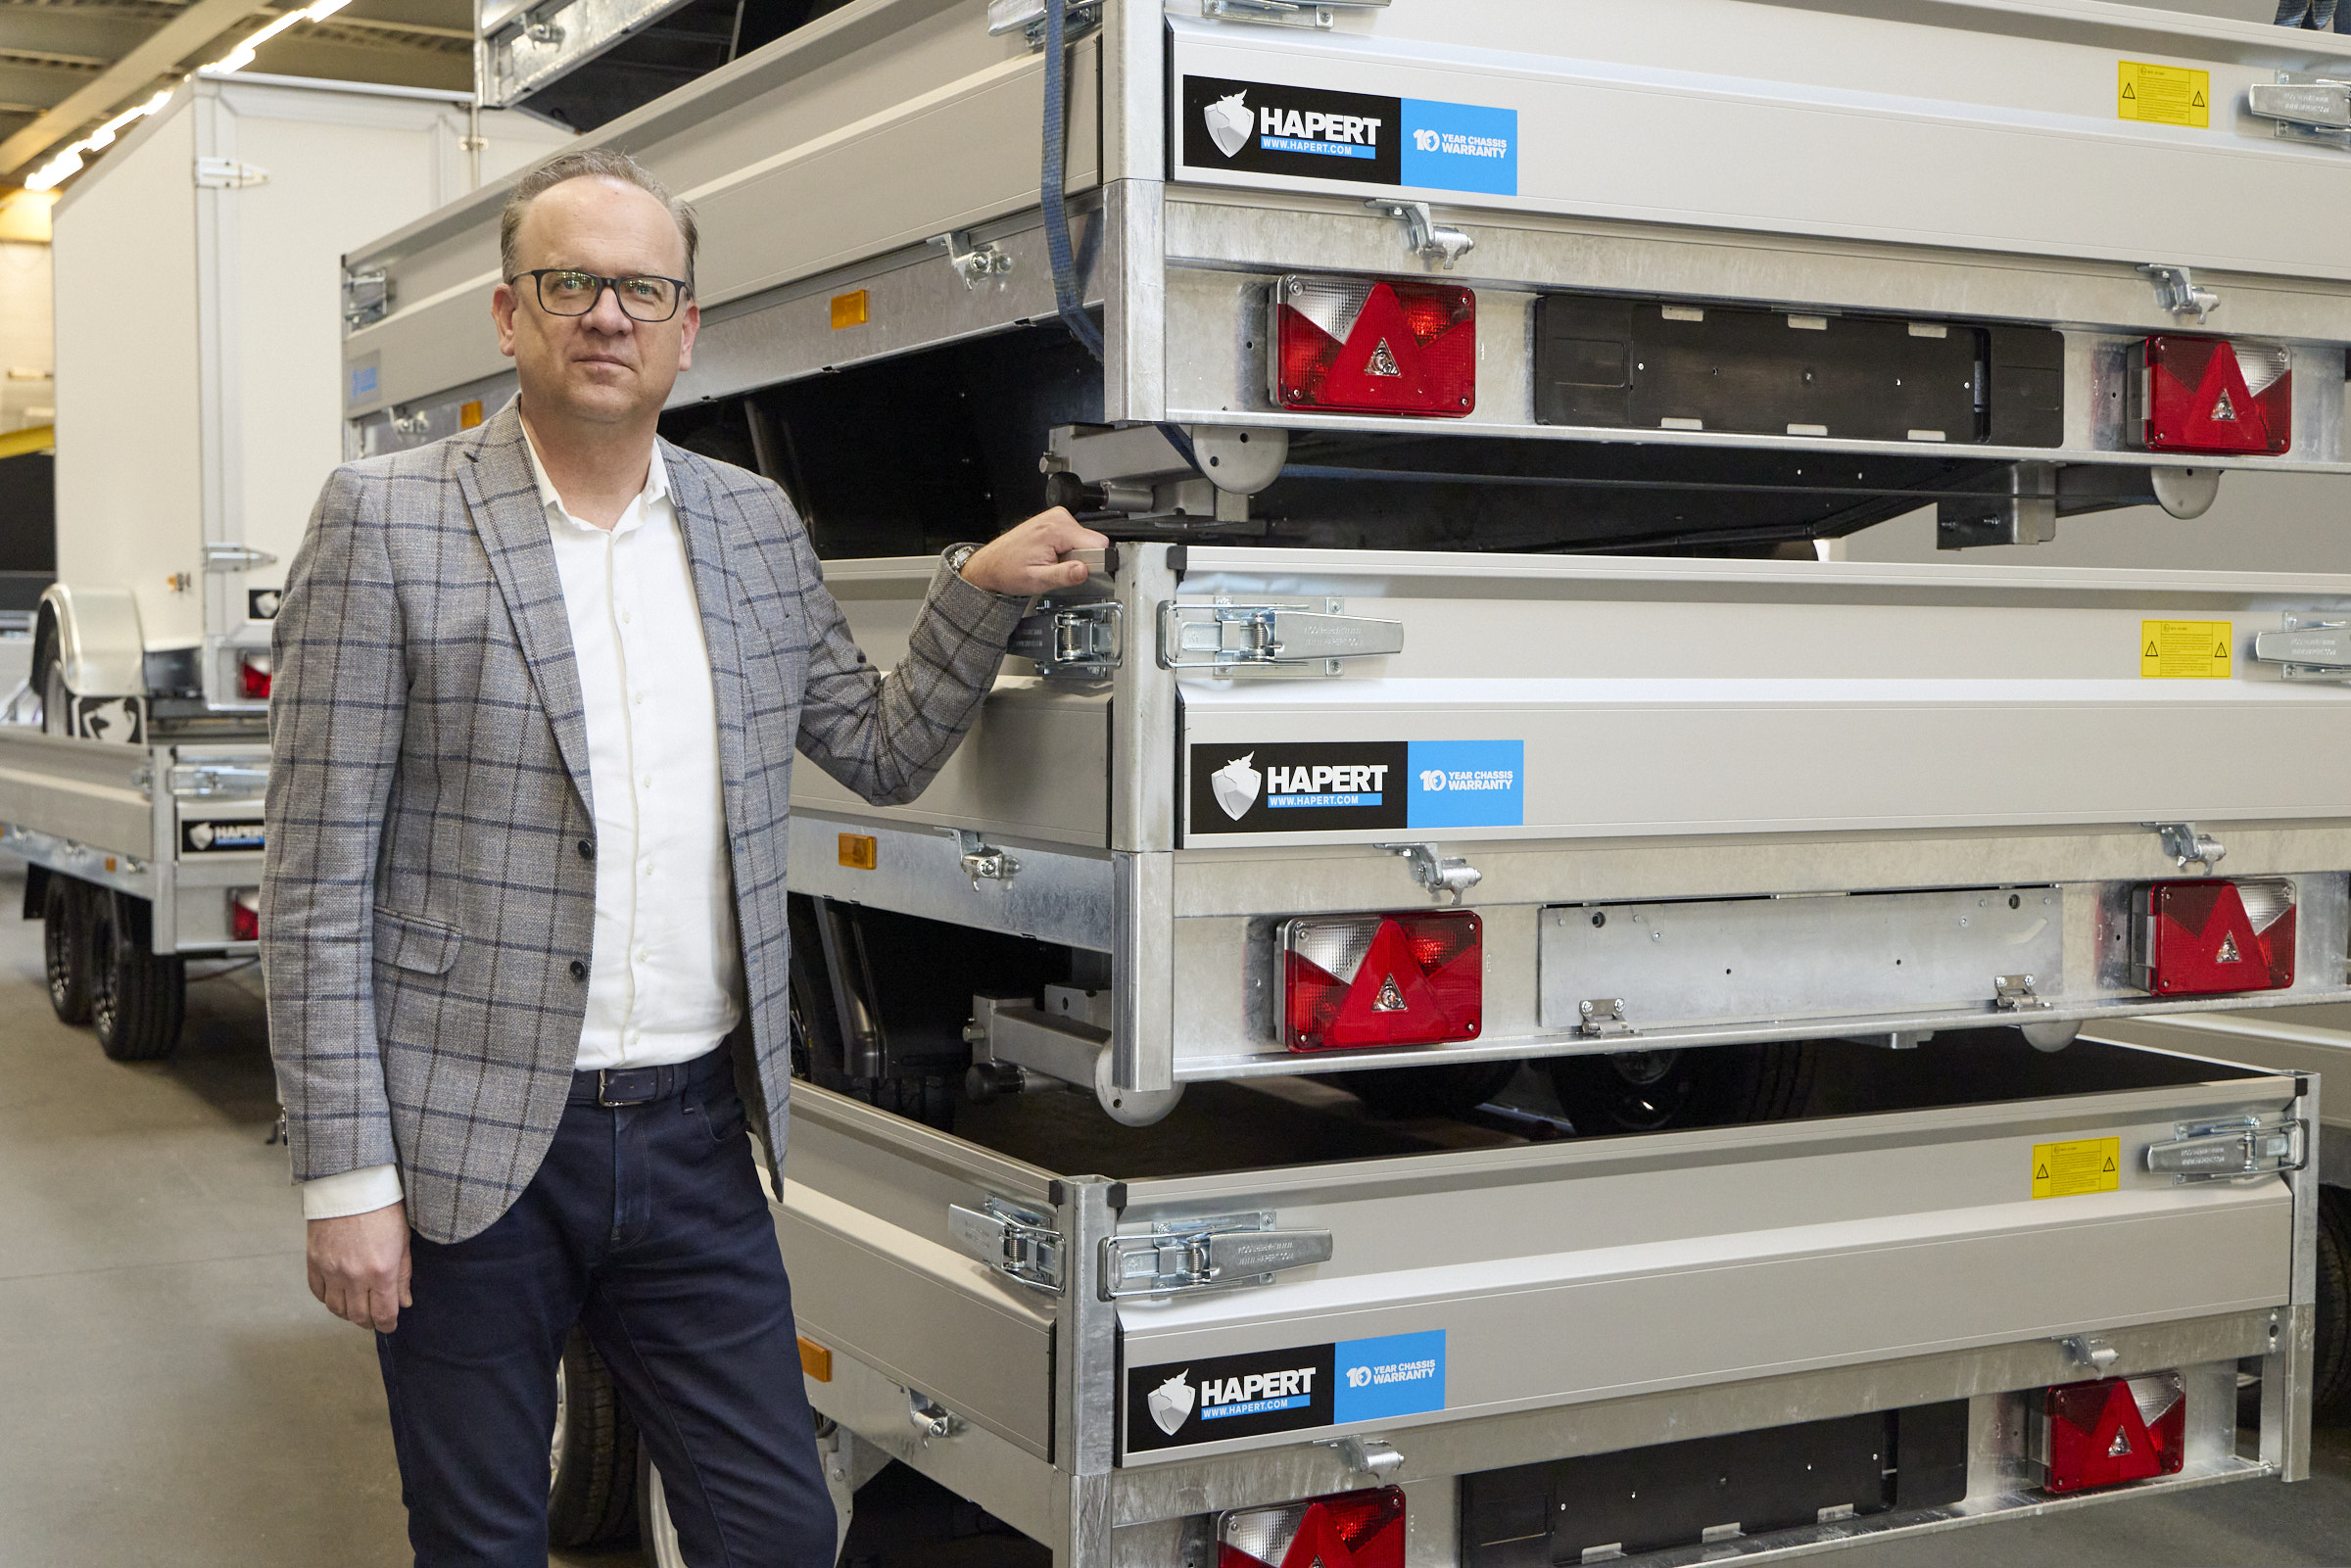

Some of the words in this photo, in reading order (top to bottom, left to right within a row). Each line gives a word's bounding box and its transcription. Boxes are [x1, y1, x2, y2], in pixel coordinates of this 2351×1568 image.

[1261, 107, 1381, 145] HAPERT
[1263, 137, 1352, 156] WWW.HAPERT.COM
[1413, 128, 1440, 152] 10
[1442, 133, 1466, 144] YEAR
[1467, 135, 1508, 149] CHASSIS
[1442, 142, 1507, 158] WARRANTY
[1268, 765, 1388, 794] HAPERT
[1419, 769, 1447, 791] 10
[1449, 771, 1472, 780] YEAR
[1474, 771, 1513, 780] CHASSIS
[1449, 780, 1513, 790] WARRANTY
[1270, 795, 1359, 806] WWW.HAPERT.COM
[1373, 1364, 1397, 1374] YEAR
[1398, 1359, 1436, 1371] CHASSIS
[1373, 1367, 1435, 1385] WARRANTY
[1201, 1367, 1317, 1406] HAPERT
[1346, 1366, 1371, 1388] 10
[1203, 1399, 1288, 1418] WWW.HAPERT.COM
